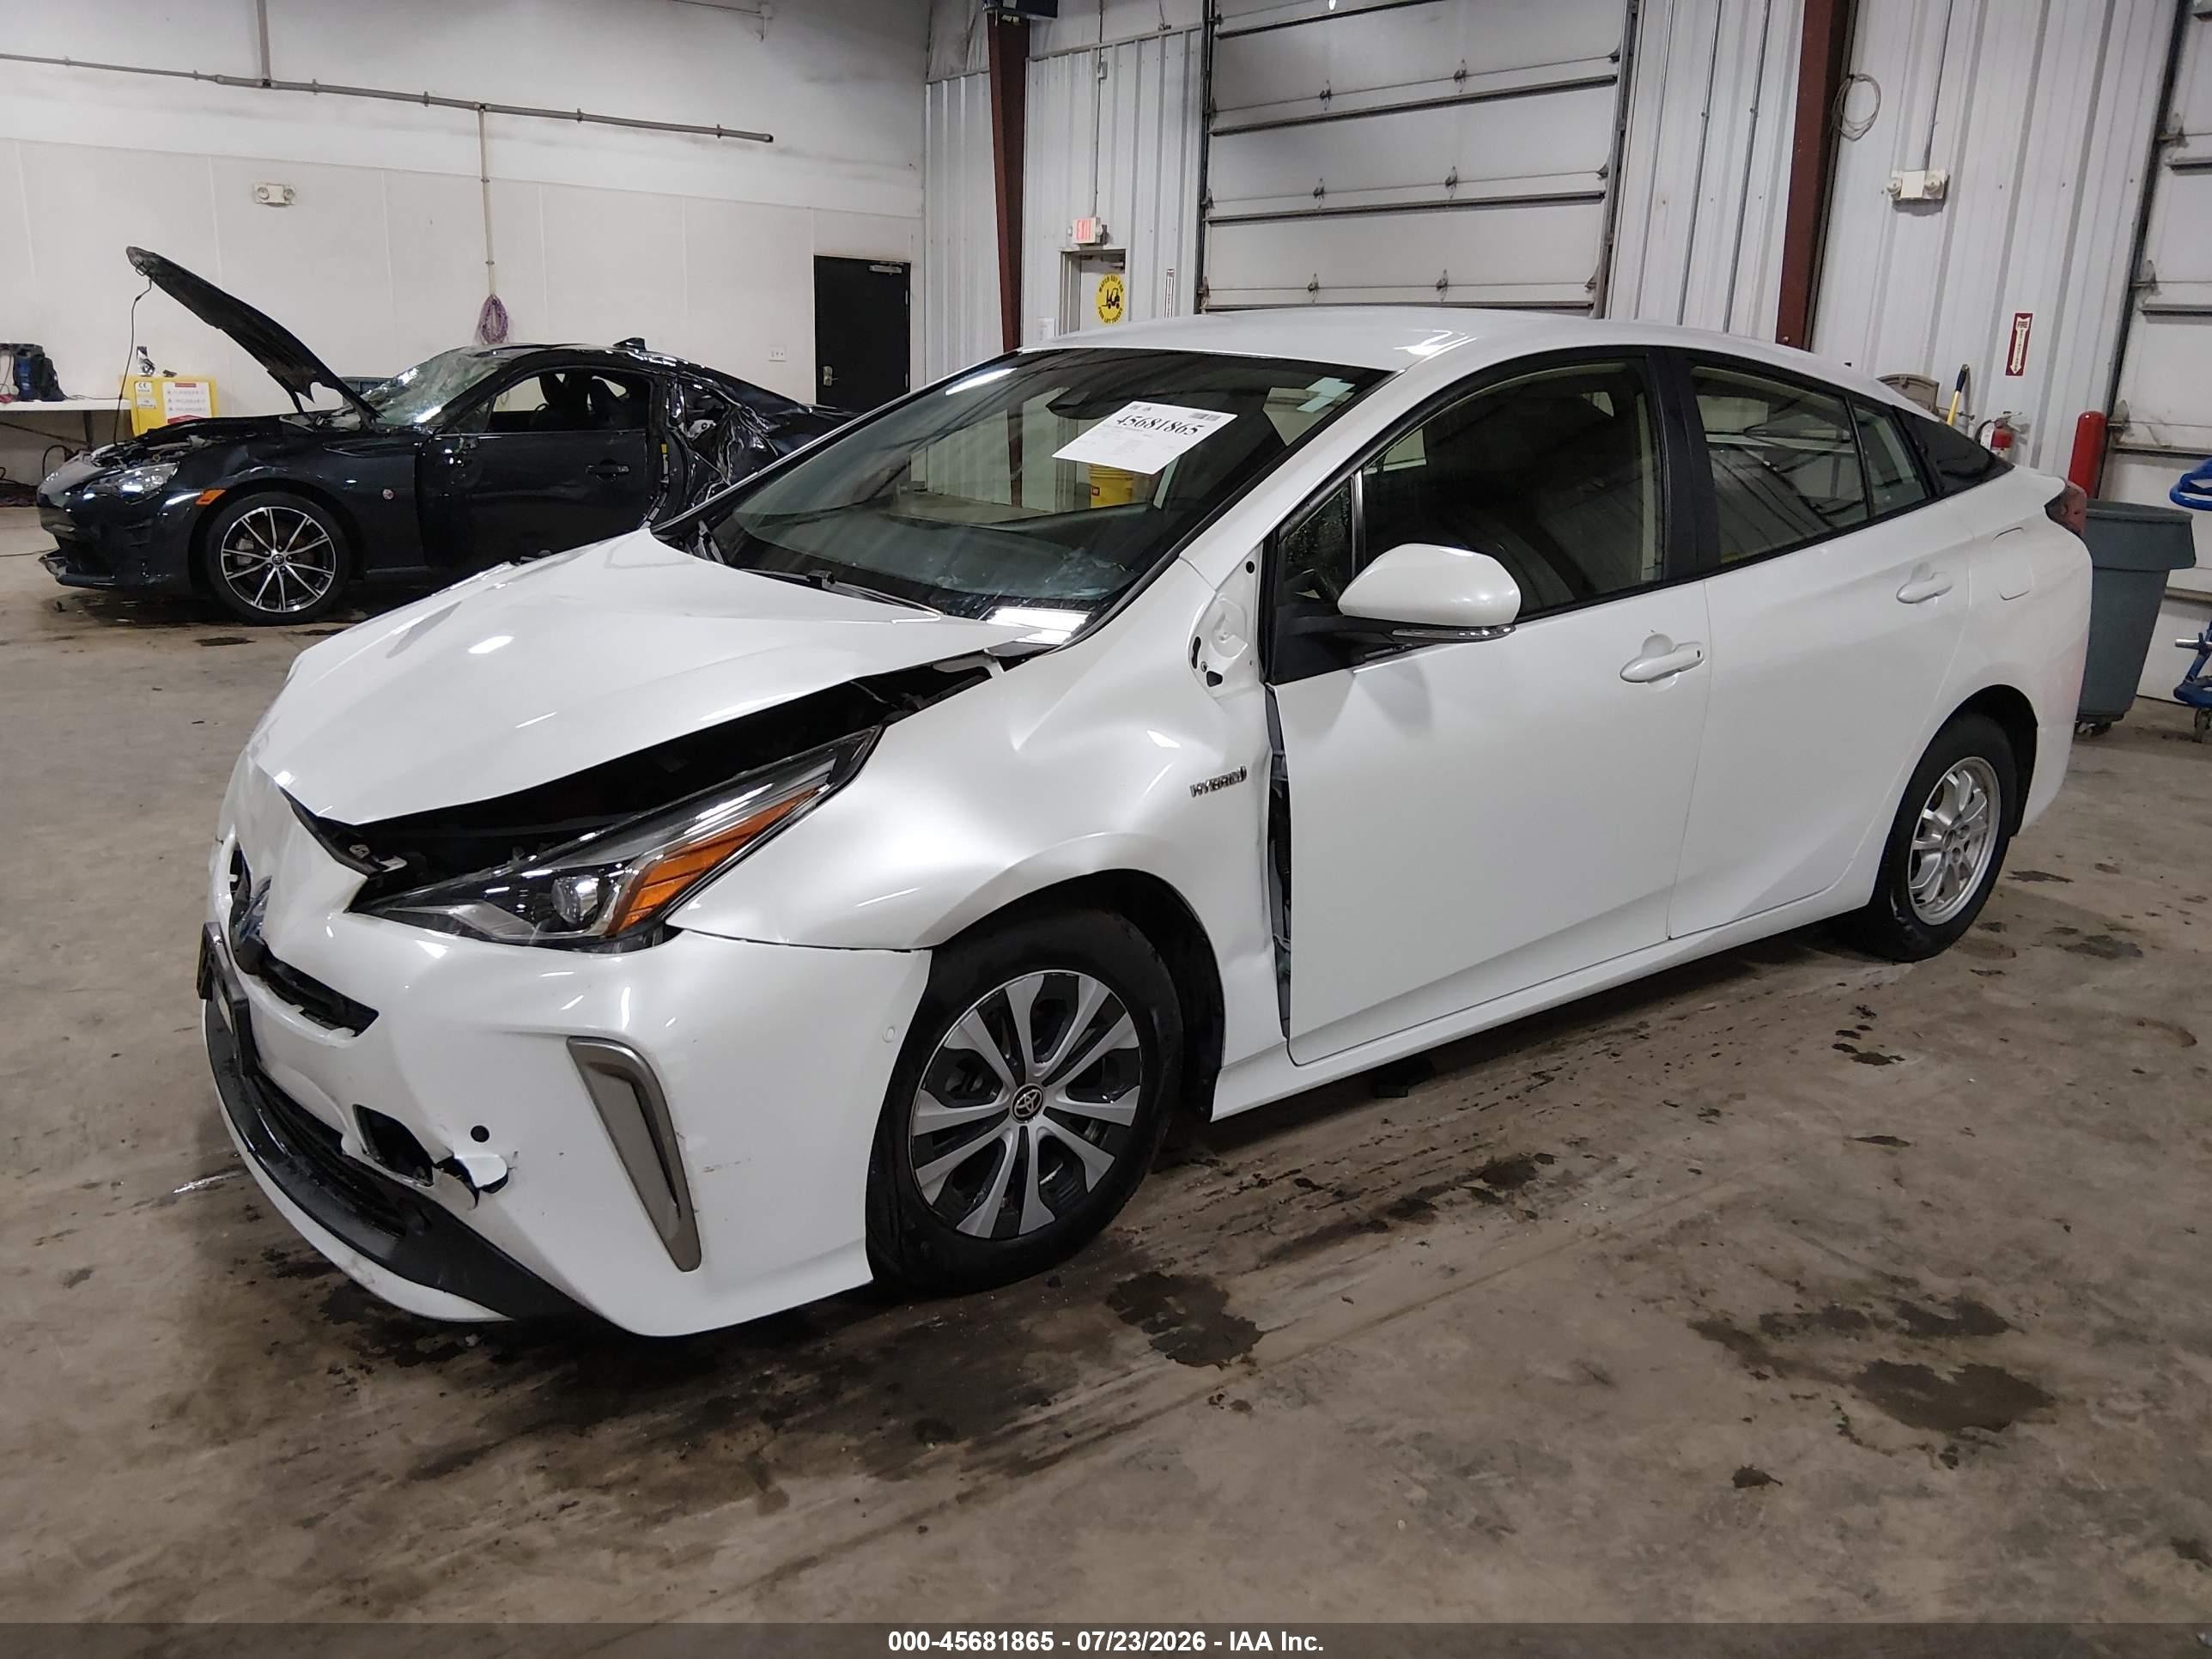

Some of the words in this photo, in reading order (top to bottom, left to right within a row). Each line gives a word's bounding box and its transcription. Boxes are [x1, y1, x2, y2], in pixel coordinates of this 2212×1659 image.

[1076, 219, 1091, 240] EXIT
[1116, 415, 1205, 435] 45681865
[1189, 765, 1248, 798] HYBRID
